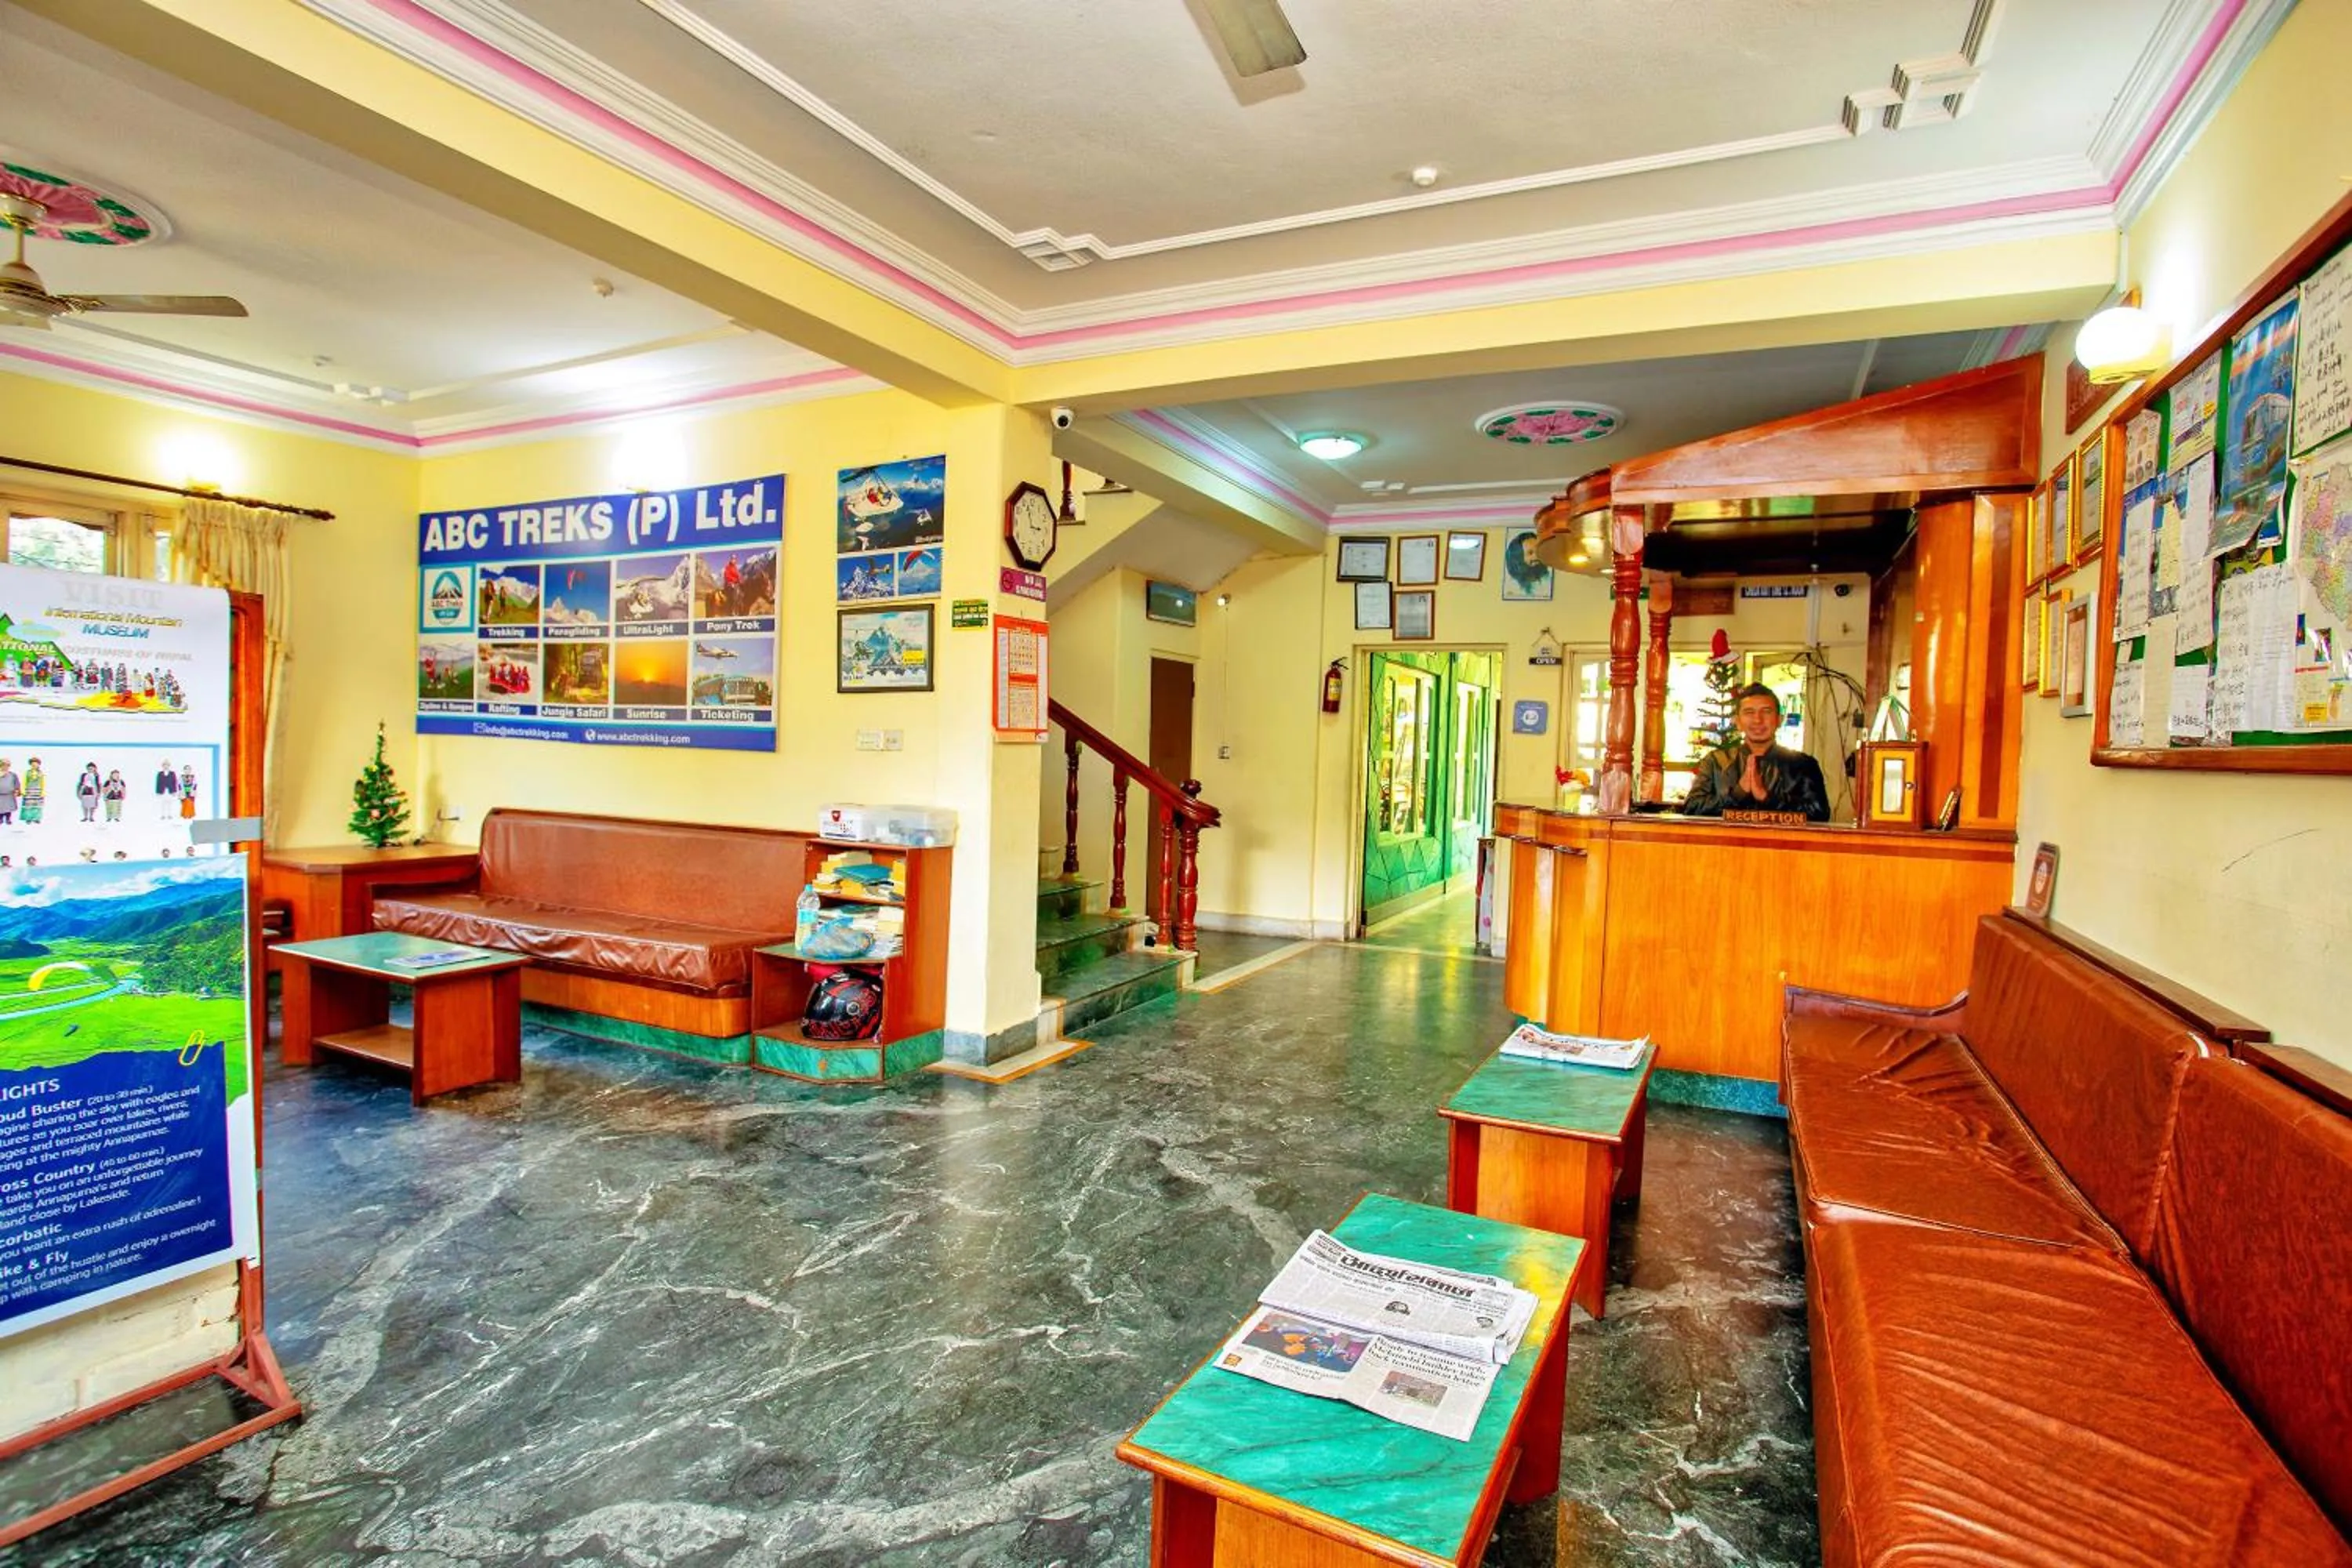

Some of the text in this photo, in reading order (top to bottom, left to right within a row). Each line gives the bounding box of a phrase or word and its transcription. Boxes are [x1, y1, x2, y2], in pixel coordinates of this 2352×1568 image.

[423, 483, 777, 553] ABC TREKS (P) Ltd.
[64, 581, 162, 609] VISIT
[82, 623, 151, 639] MUSEUM
[487, 628, 525, 638] Trekking
[547, 627, 601, 638] Paragliding
[706, 620, 760, 632] Pony Trek
[488, 703, 521, 716] Rafting
[542, 706, 607, 718] Jungle Safari
[626, 709, 666, 720] Sunrise
[701, 710, 756, 721] Ticketing
[597, 732, 691, 745] www.abctrekking.com
[1726, 811, 1803, 823] RECEPTION
[0, 1078, 60, 1102] IGHTS
[31, 1098, 83, 1116] Buster
[32, 1112, 77, 1128] sharing
[78, 1107, 98, 1119] the
[121, 1098, 143, 1109] with
[49, 1126, 71, 1138] you
[61, 1142, 102, 1158] mighty
[0, 1178, 30, 1193] oss
[33, 1162, 96, 1185] Country
[109, 1177, 130, 1189] and
[5, 1190, 32, 1204] take
[34, 1185, 57, 1199] you
[62, 1202, 78, 1214] by
[12, 1274, 32, 1288] out
[34, 1269, 48, 1281] of
[49, 1263, 69, 1276] the
[108, 1244, 129, 1259] and
[130, 1236, 159, 1251] enjoy
[28, 1258, 40, 1270] &
[45, 1250, 69, 1265] Fly
[40, 1269, 91, 1290] camping
